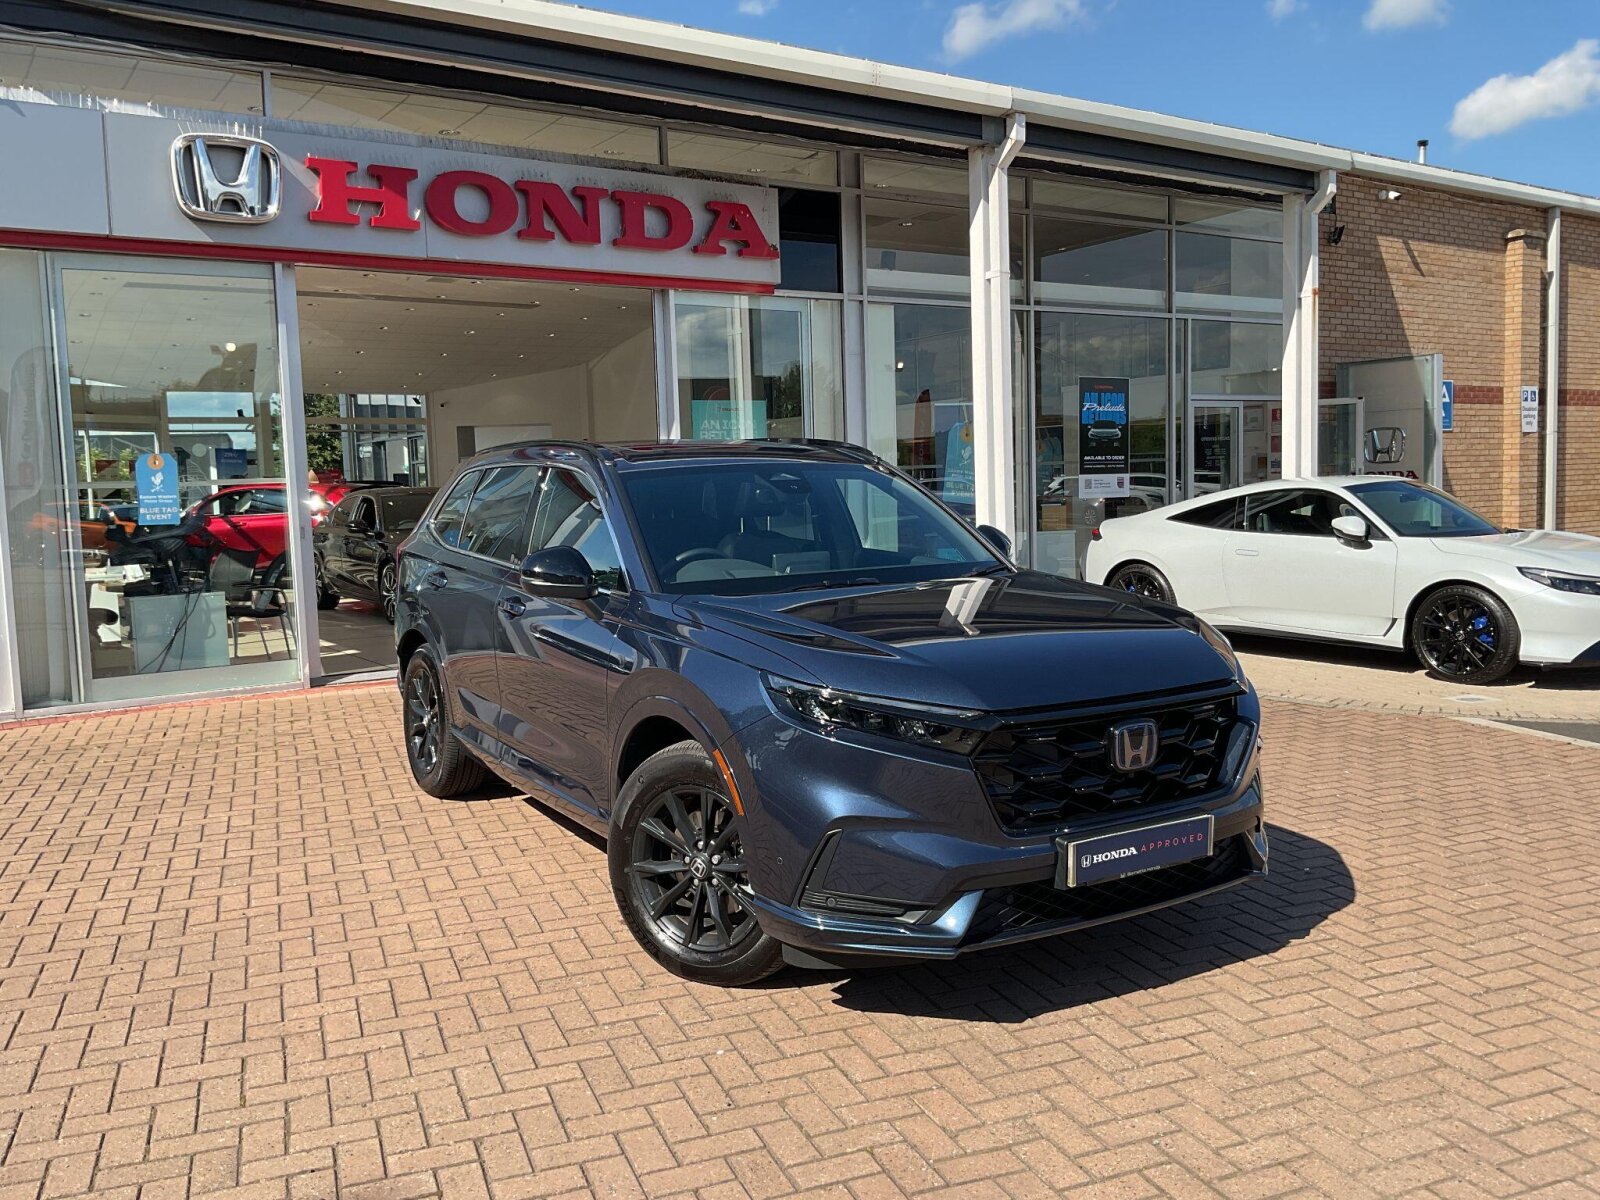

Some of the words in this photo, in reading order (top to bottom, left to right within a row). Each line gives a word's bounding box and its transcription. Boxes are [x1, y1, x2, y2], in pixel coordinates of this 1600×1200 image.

[304, 154, 780, 260] HONDA
[1082, 402, 1125, 411] Prelude
[701, 420, 720, 430] AN
[1093, 847, 1138, 864] HONDA
[1141, 833, 1203, 852] APPROVED
